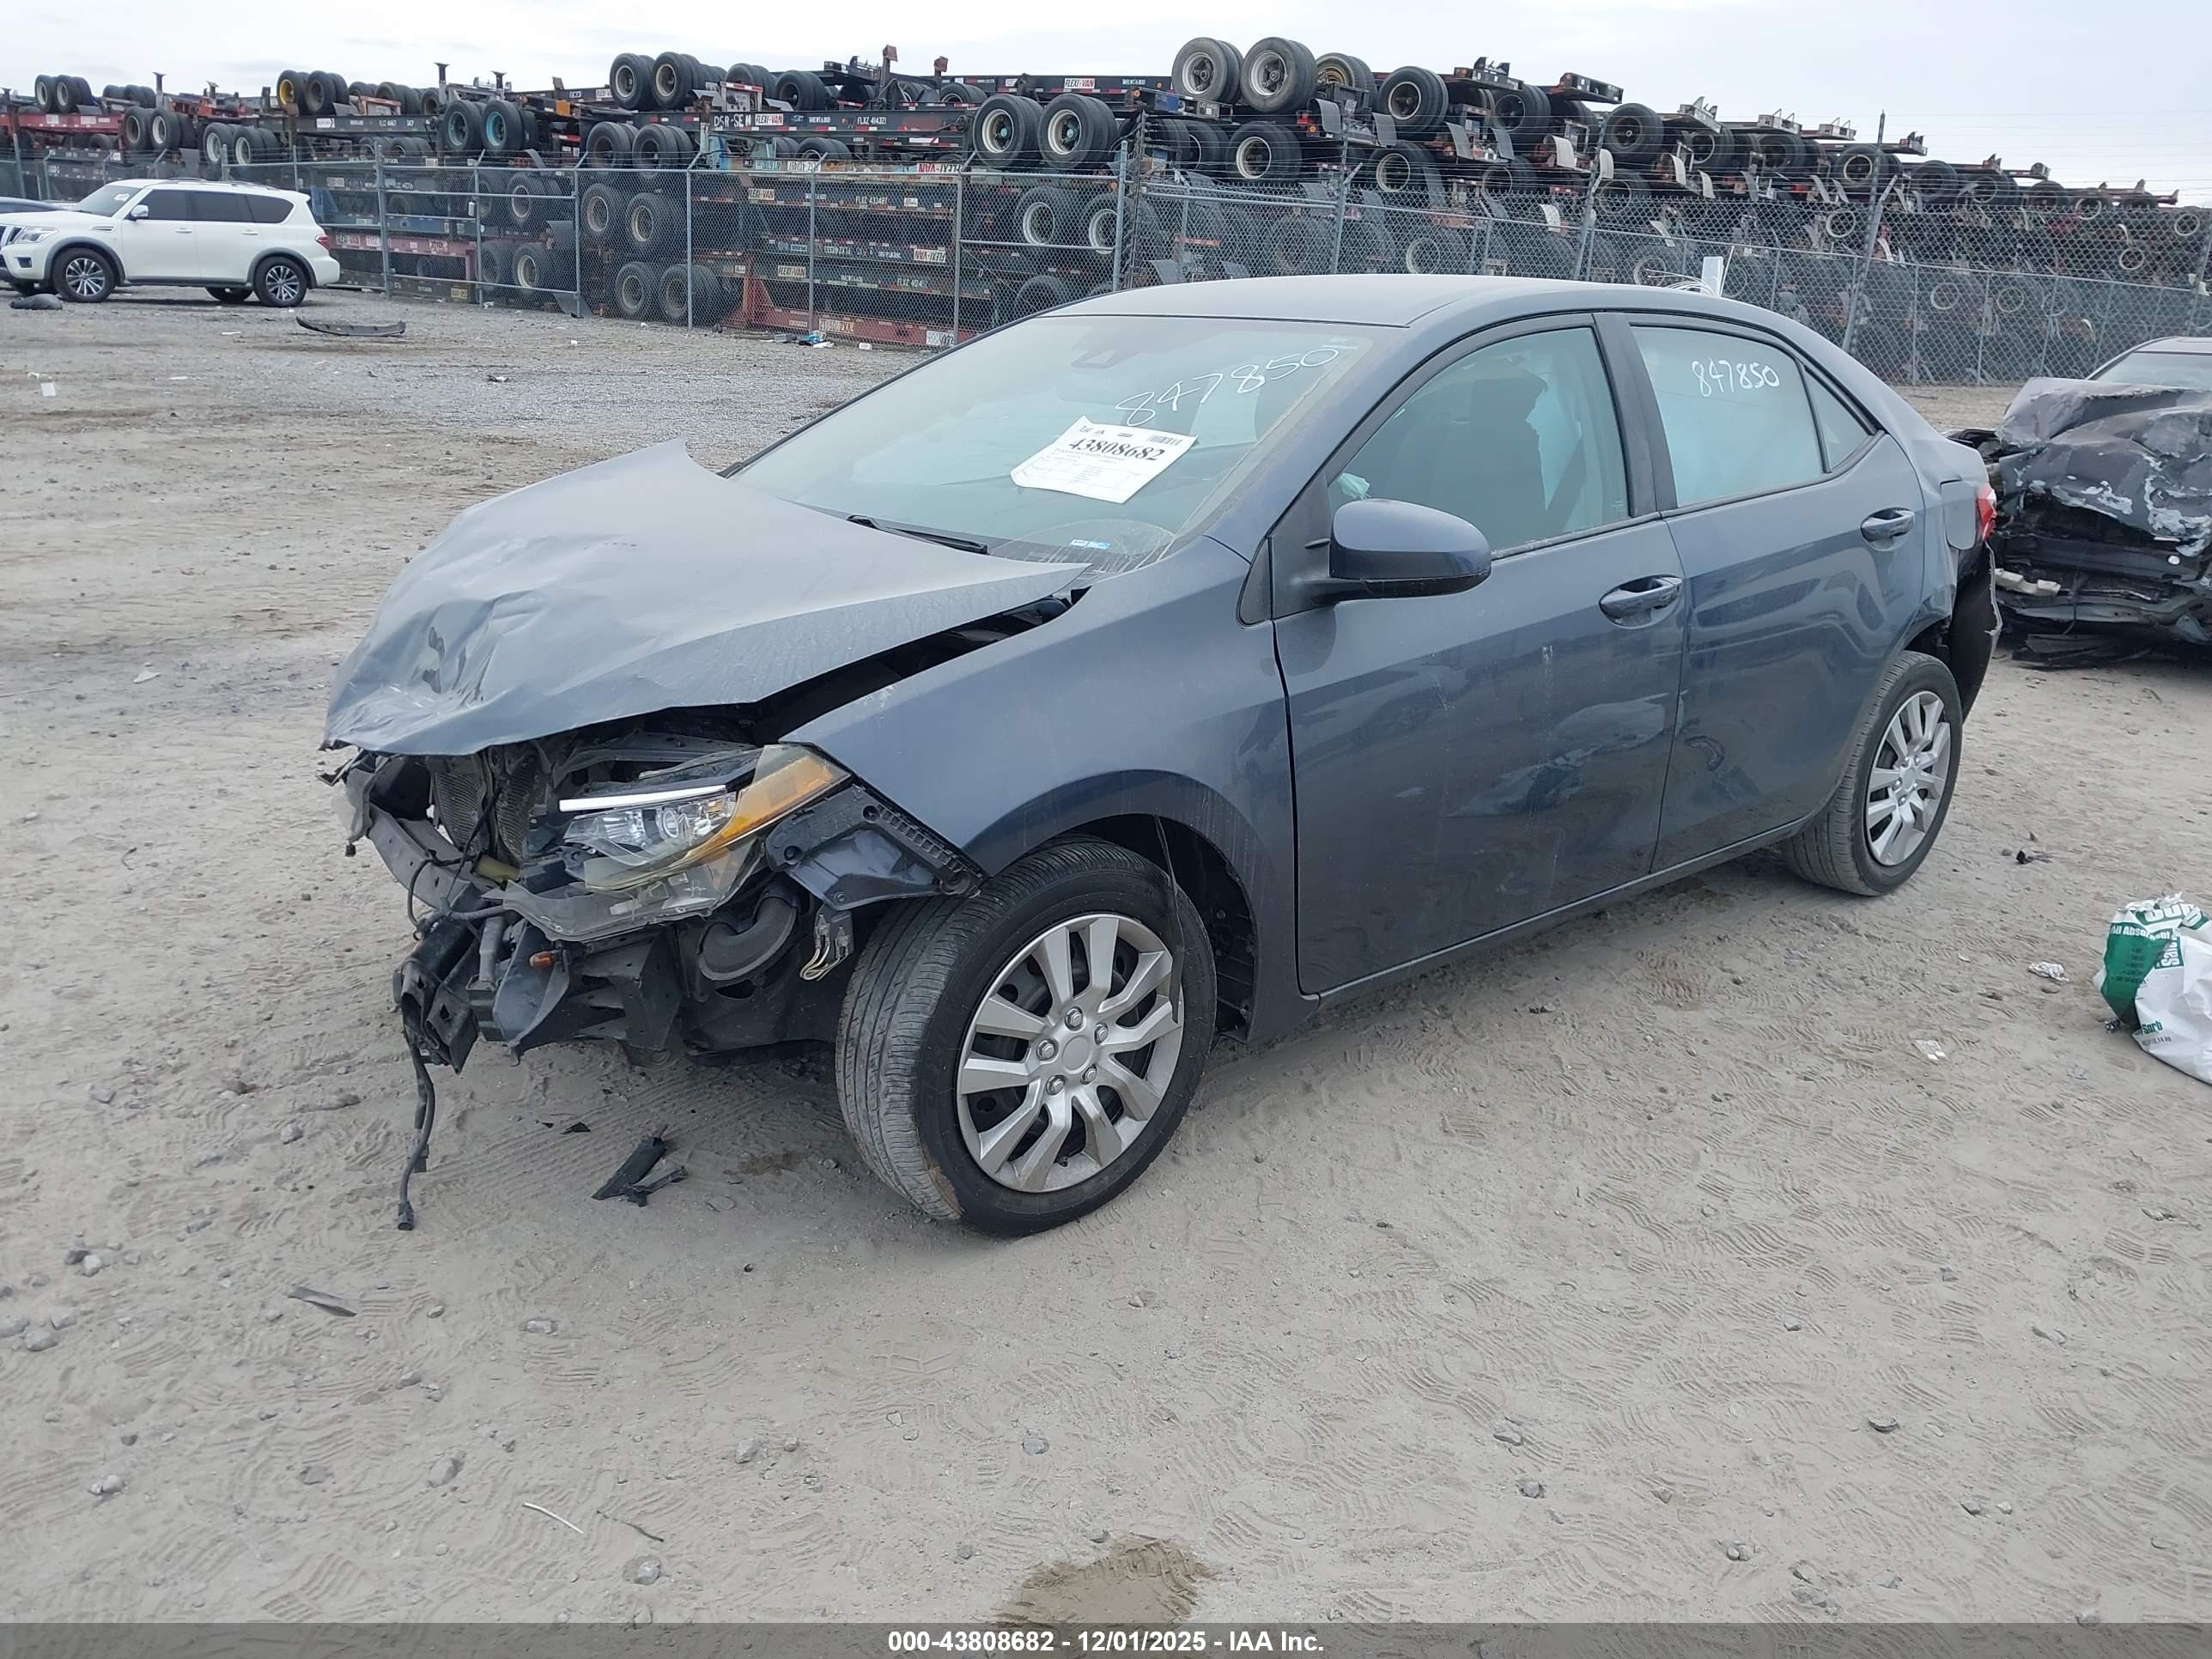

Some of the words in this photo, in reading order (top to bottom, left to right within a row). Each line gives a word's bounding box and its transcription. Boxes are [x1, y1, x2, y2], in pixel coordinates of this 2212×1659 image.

[1064, 78, 1095, 88] FLEXI-VAN
[756, 114, 783, 125] FLEXI-VAN
[914, 248, 945, 263] FLEXI-VAN
[1692, 358, 1780, 397] 847850
[1115, 348, 1340, 427] 847850
[1070, 438, 1165, 460] 43808682
